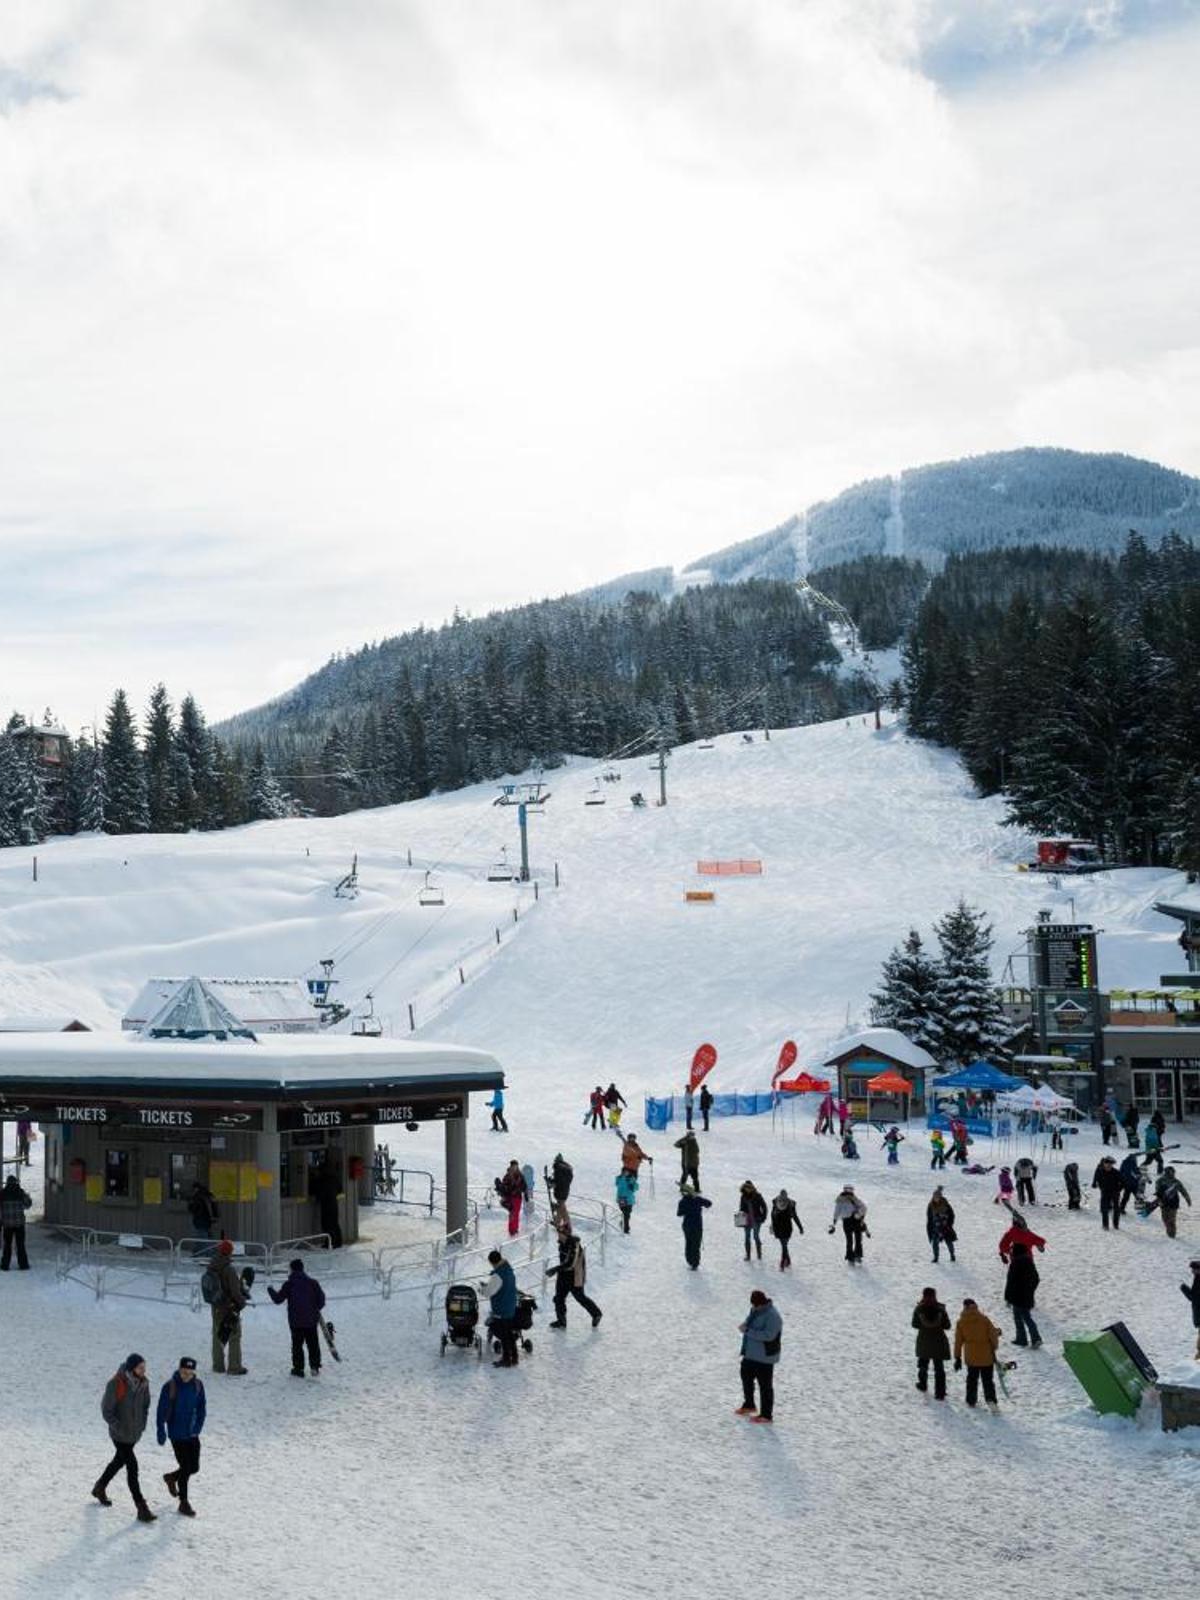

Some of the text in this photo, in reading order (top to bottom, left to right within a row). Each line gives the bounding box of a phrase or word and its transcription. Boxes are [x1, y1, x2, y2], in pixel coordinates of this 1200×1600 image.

[56, 1106, 193, 1125] TICKETS TICKETS
[303, 1111, 341, 1125] TICKETS
[378, 1106, 414, 1121] TICKETS
